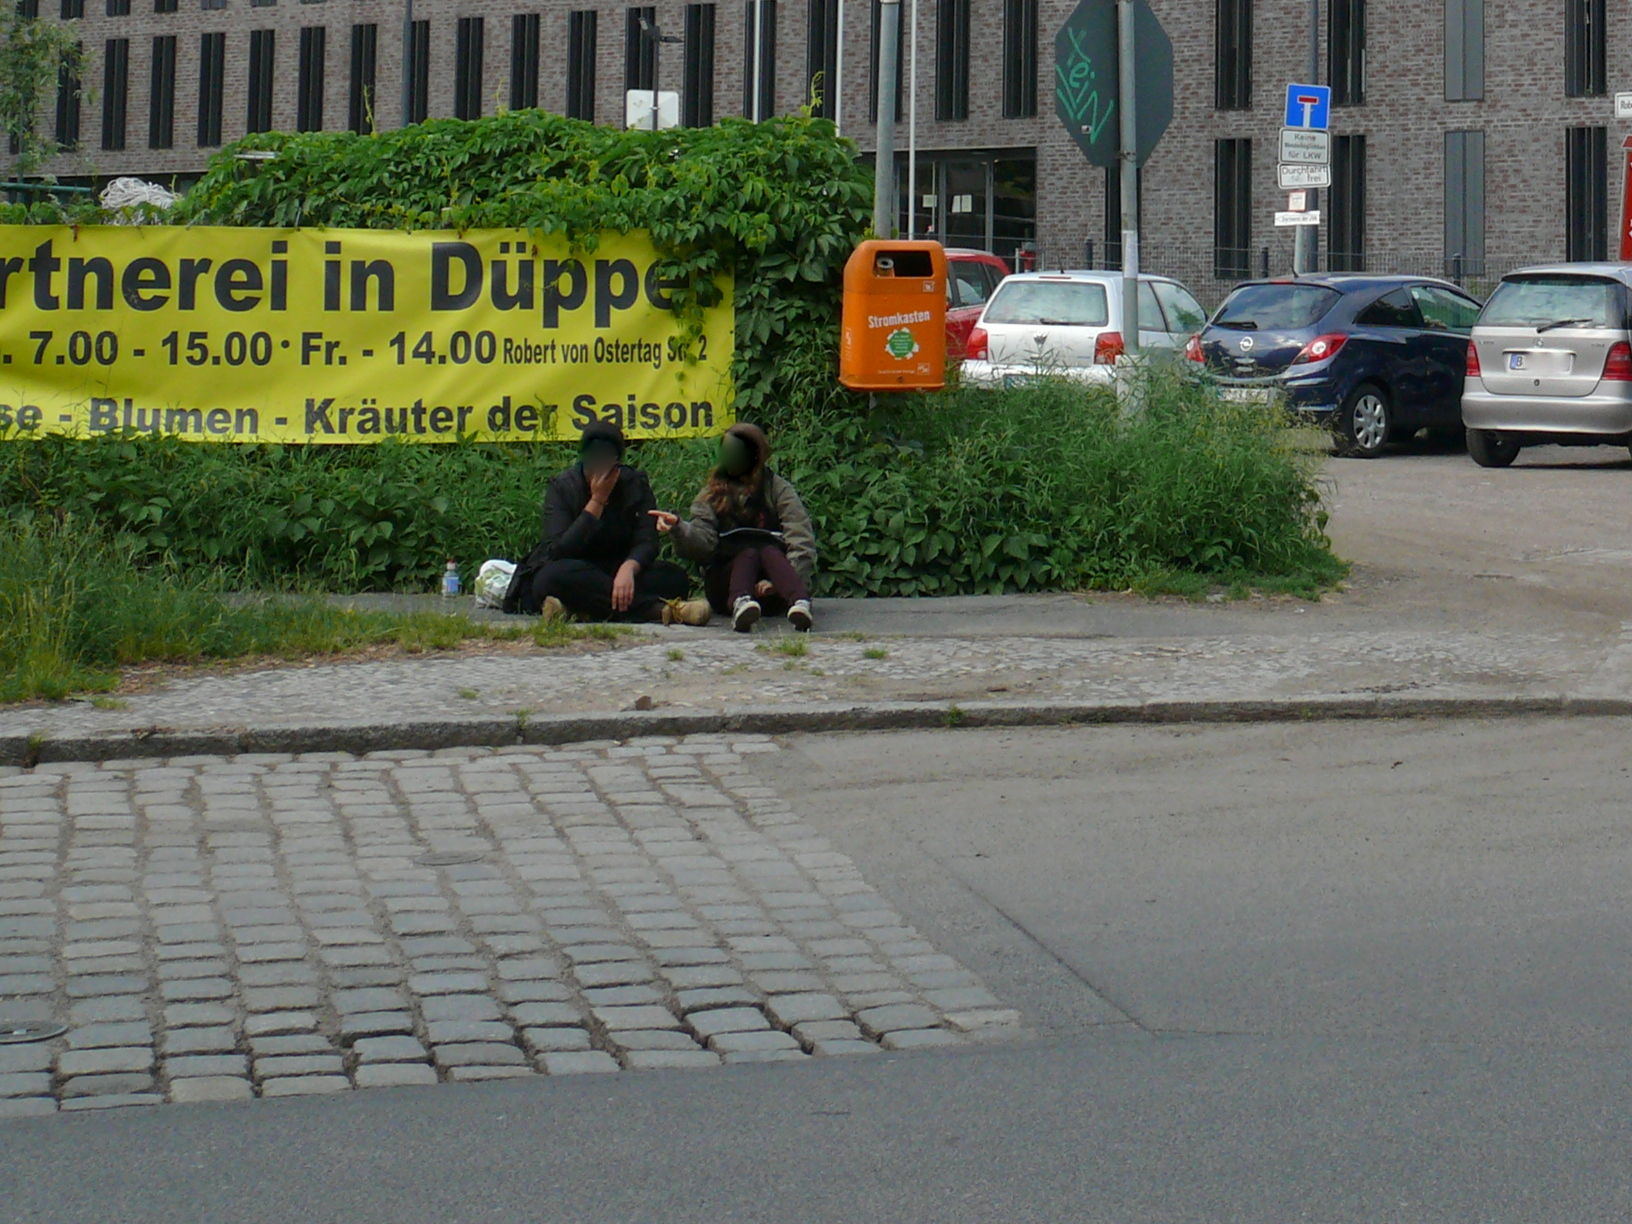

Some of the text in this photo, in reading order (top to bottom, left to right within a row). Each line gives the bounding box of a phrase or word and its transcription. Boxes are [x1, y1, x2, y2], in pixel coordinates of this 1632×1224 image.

[1294, 133, 1316, 141] Keine
[325, 240, 395, 311] in
[431, 241, 712, 329] Düppe
[868, 310, 931, 329] Stromkasten
[29, 330, 118, 365] 7.00
[301, 332, 347, 366] Fr.
[390, 330, 496, 366] 14.00
[504, 337, 556, 365] Robert
[561, 344, 588, 364] von
[594, 337, 661, 369] Ostertag
[698, 334, 707, 361] 2
[89, 397, 260, 435] Blumen
[305, 397, 474, 435] Kräuter
[488, 395, 558, 433] der
[572, 393, 713, 431] Saison
